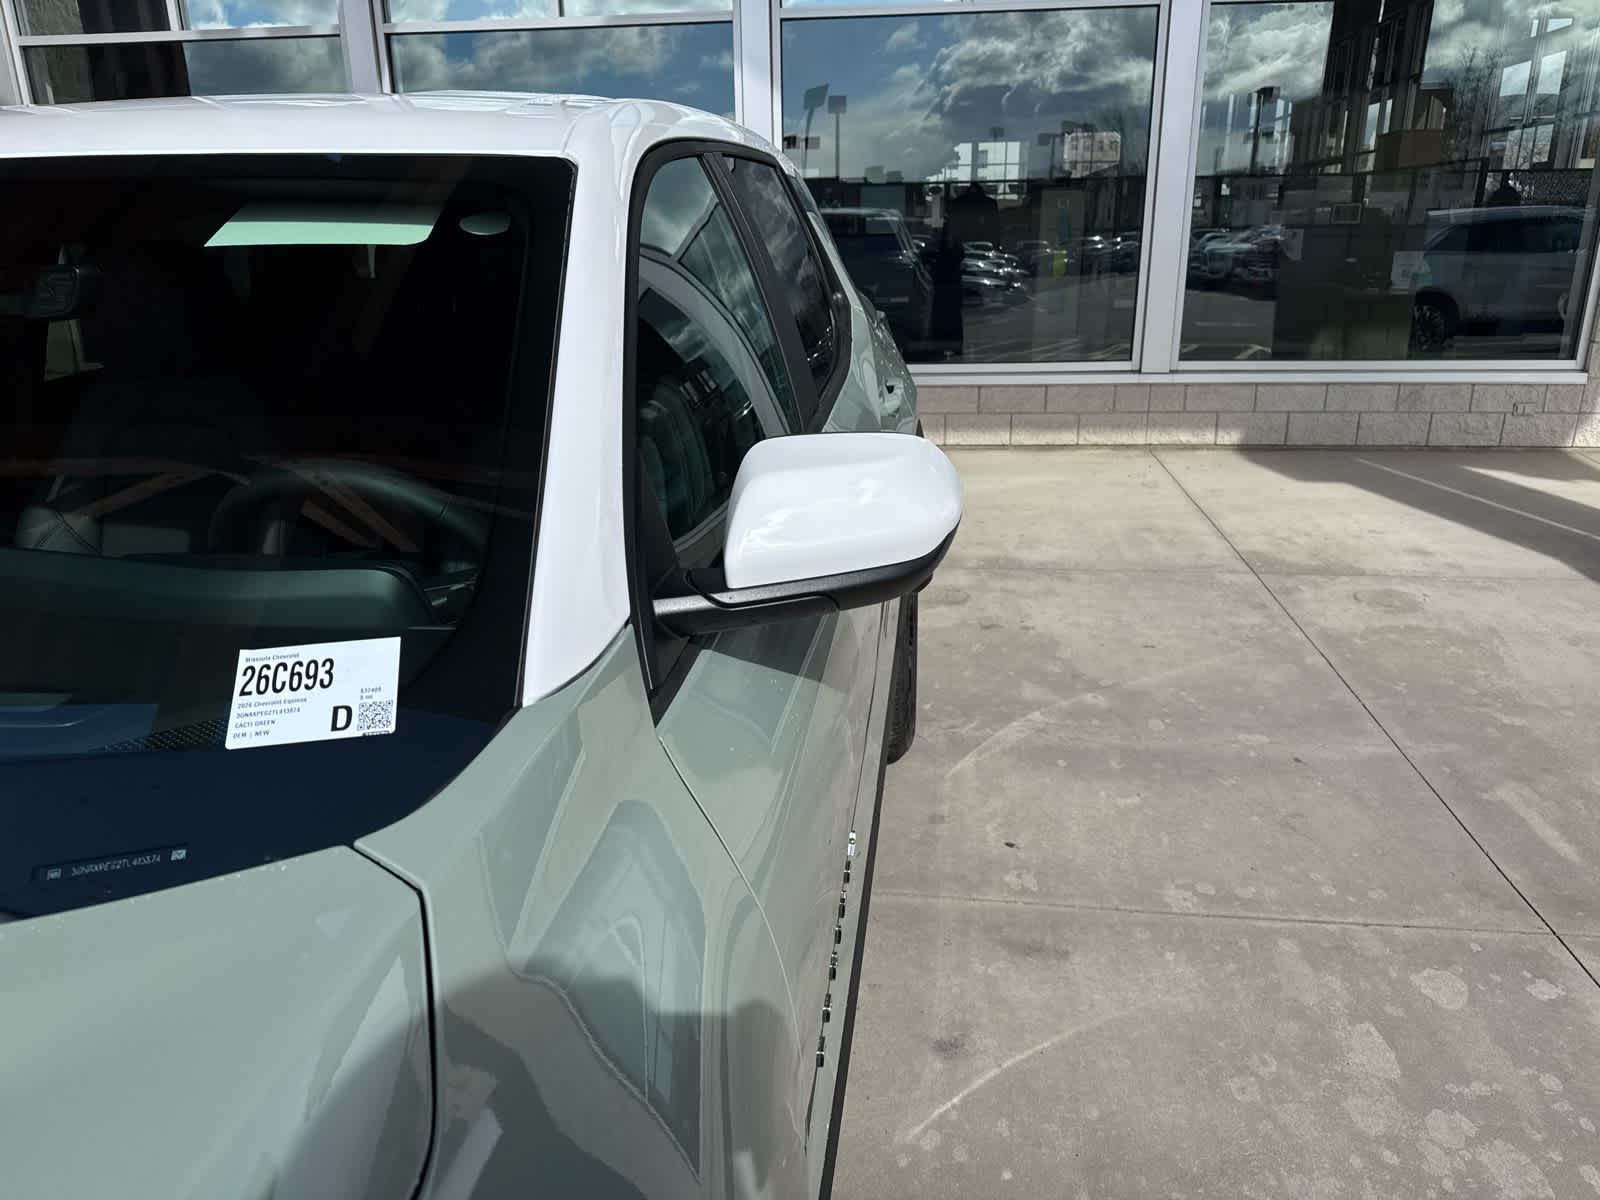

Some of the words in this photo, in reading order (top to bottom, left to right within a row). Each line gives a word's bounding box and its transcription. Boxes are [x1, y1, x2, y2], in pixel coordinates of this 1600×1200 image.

[239, 657, 335, 697] 26C693
[254, 719, 277, 727] GREEN
[330, 704, 353, 732] D
